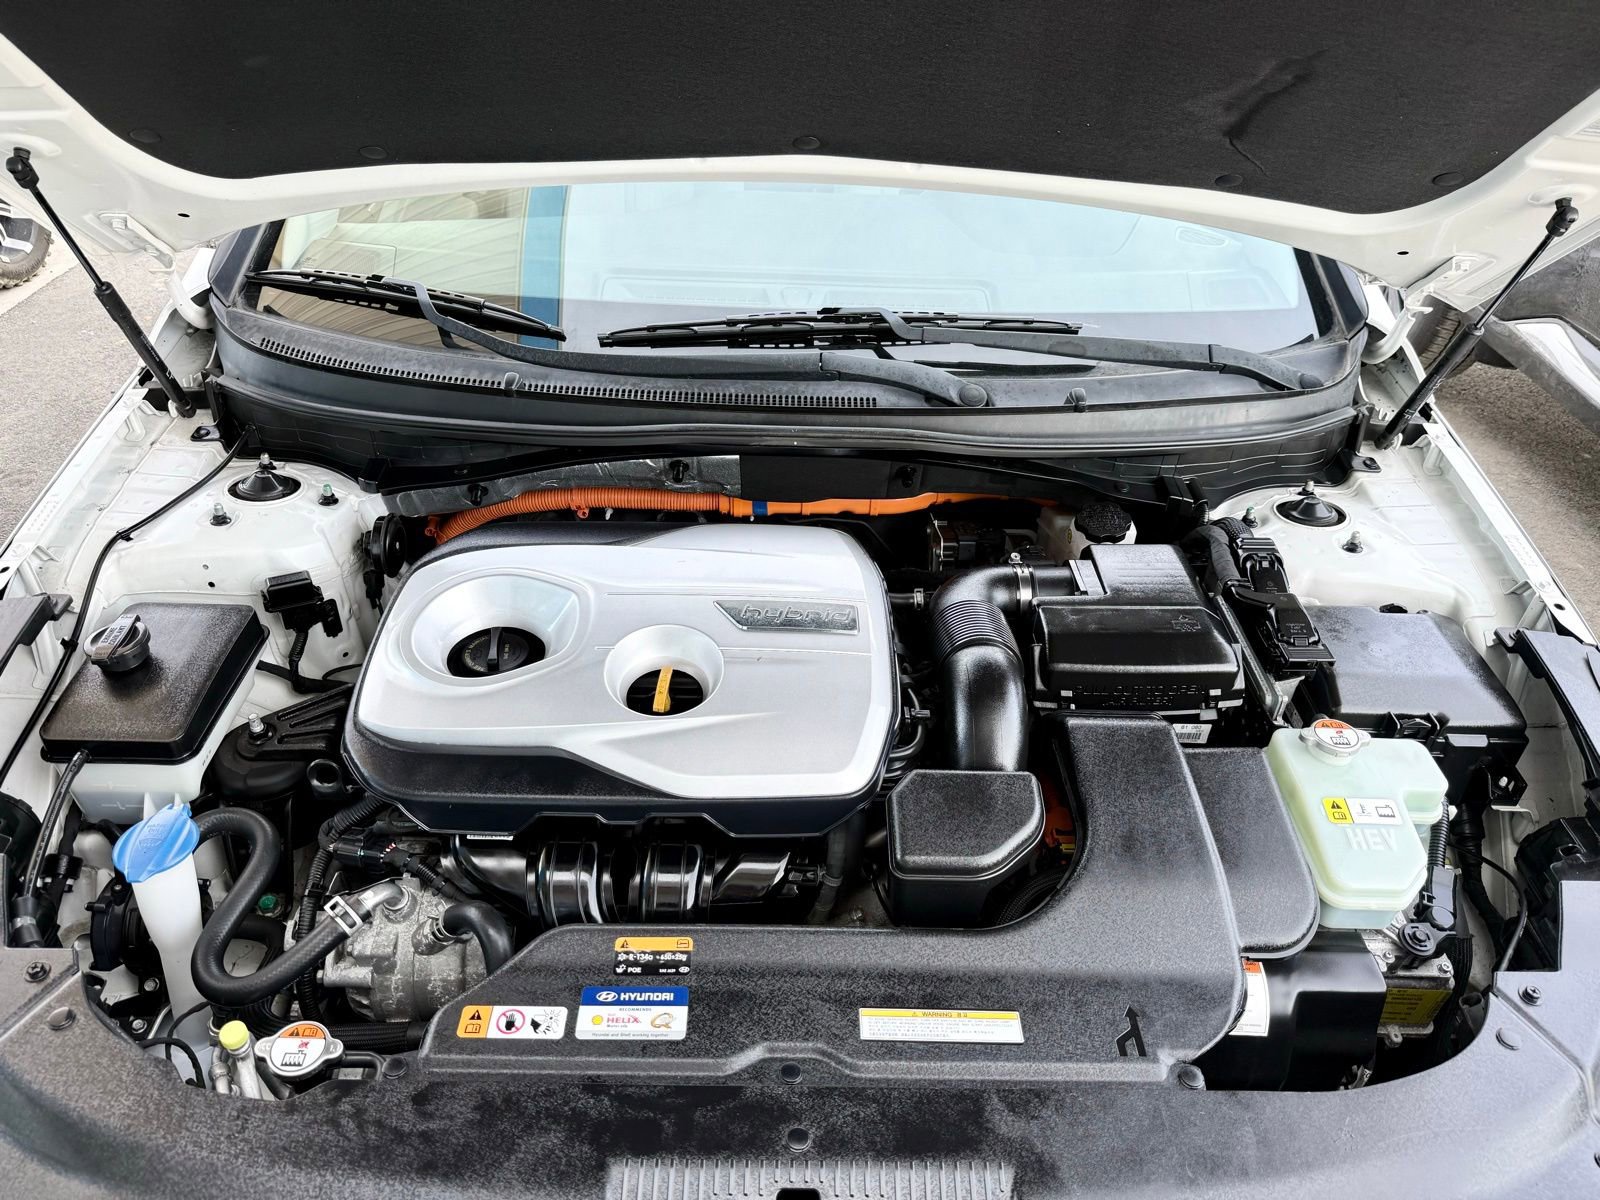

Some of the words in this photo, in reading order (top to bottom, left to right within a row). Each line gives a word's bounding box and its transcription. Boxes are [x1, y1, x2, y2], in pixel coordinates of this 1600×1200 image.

[741, 605, 853, 622] hybrid
[620, 992, 674, 1001] HYUNDAI
[607, 1015, 641, 1024] HELIX
